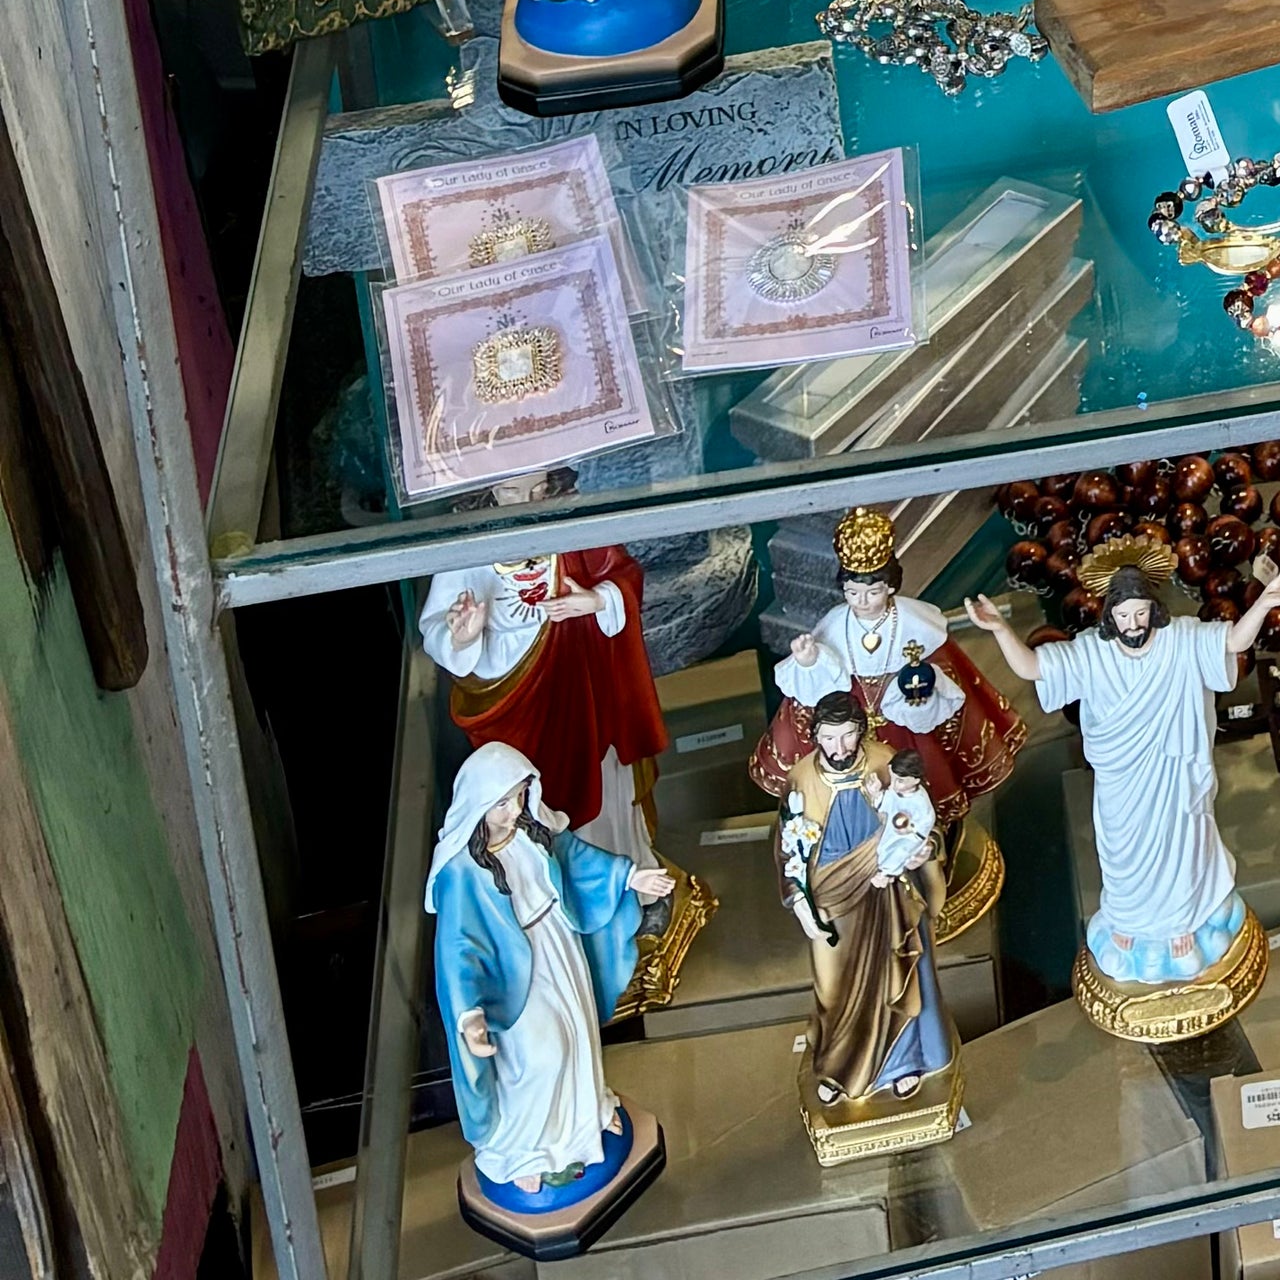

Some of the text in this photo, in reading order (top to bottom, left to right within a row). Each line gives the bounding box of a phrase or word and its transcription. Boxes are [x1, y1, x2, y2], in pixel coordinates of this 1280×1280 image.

[615, 101, 757, 141] IN LOVING
[1186, 111, 1208, 154] Roman
[431, 161, 547, 189] Our Lady of Grace
[637, 139, 840, 193] Memory
[739, 172, 852, 201] Our Lady of Grace
[437, 262, 558, 298] Our Lady of Grace
